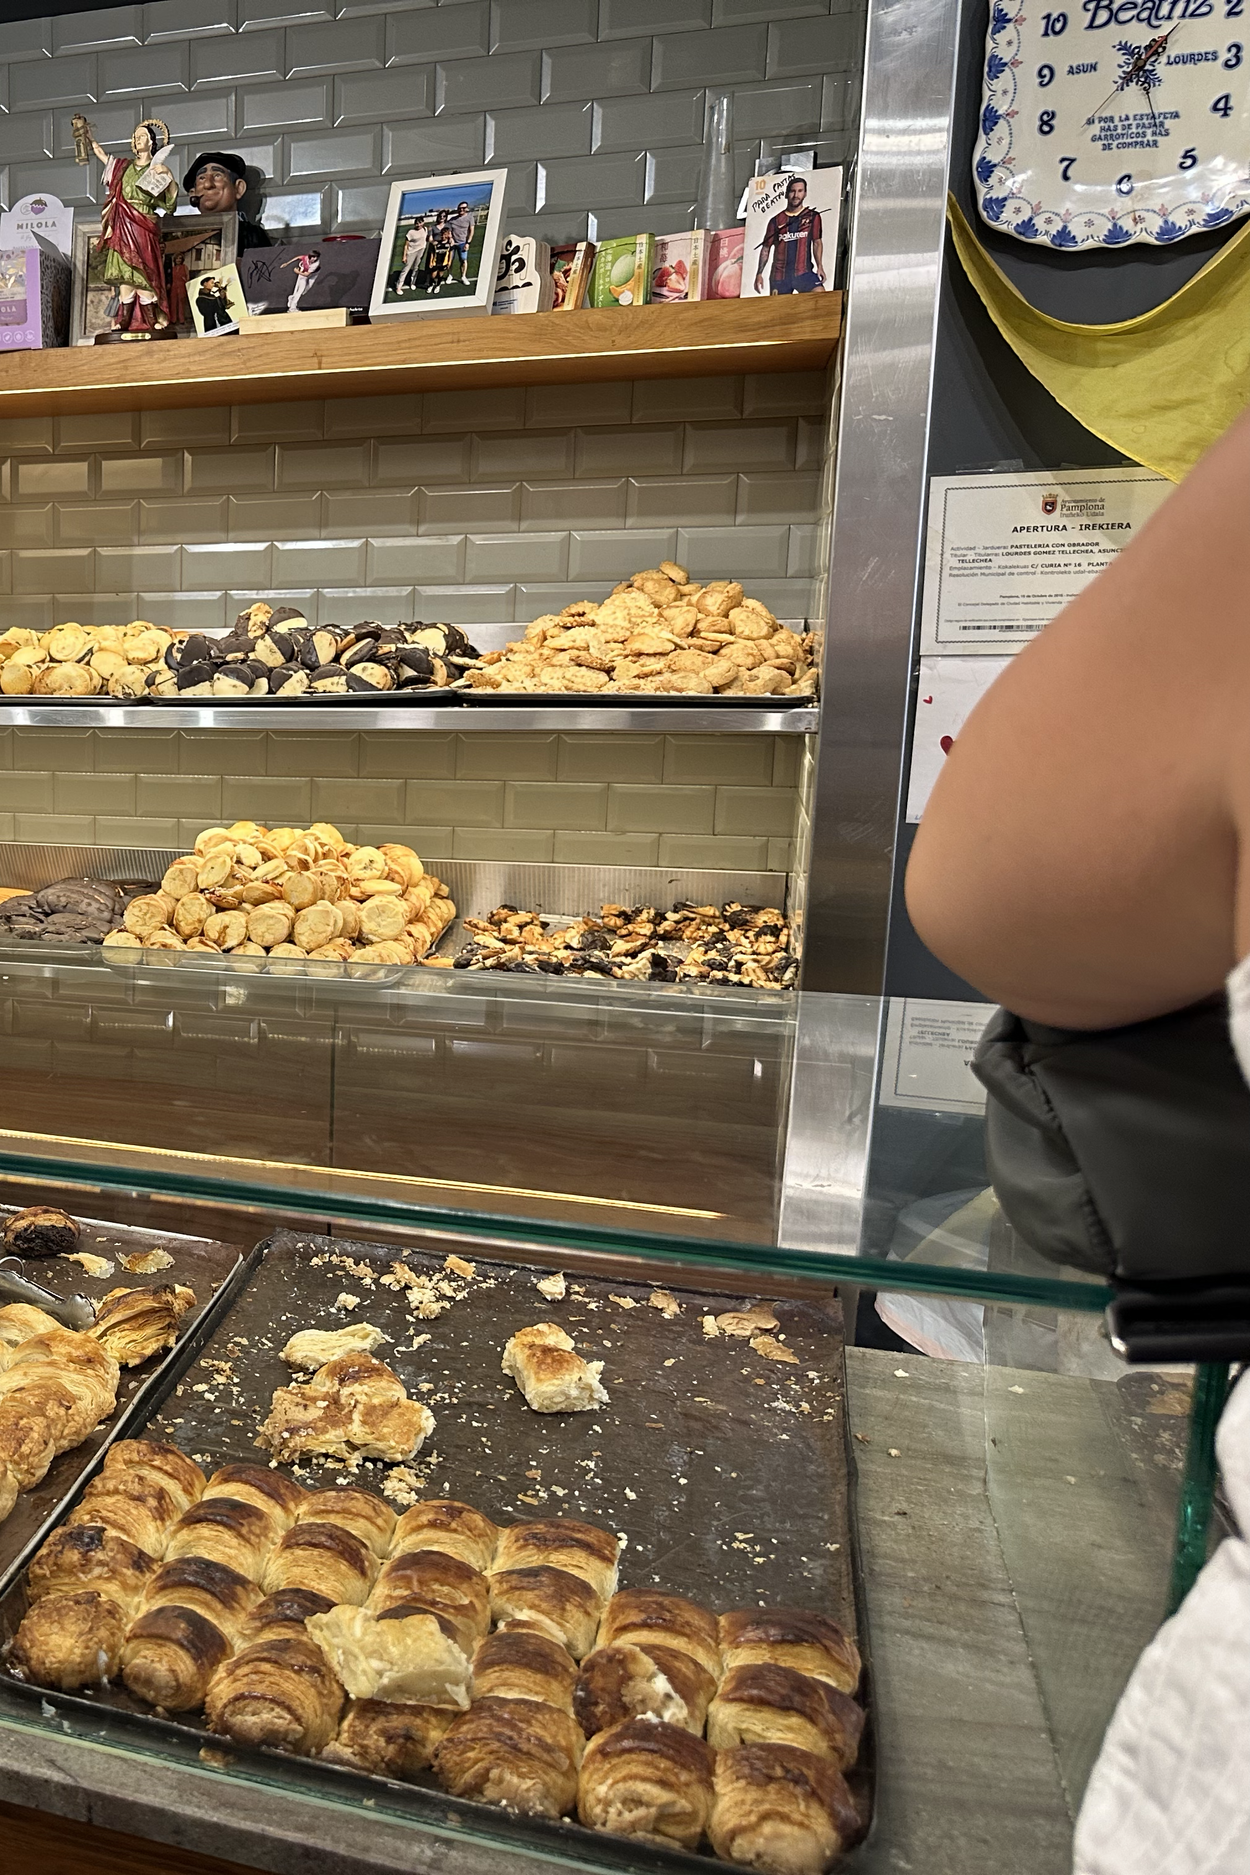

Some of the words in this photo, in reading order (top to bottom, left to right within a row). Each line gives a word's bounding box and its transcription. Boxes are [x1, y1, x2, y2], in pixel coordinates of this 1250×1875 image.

[1041, 11, 1069, 37] 10
[1165, 51, 1219, 66] LOURDES
[1222, 42, 1243, 70] 3
[1037, 63, 1055, 88] 9
[1067, 62, 1098, 76] ASUN
[1210, 93, 1234, 118] 4
[1037, 109, 1056, 136] 8
[1098, 116, 1114, 124] POR
[1133, 111, 1180, 122] ESTAFETA
[1100, 125, 1118, 133] HAS
[1136, 121, 1165, 130] PASAR
[1152, 129, 1170, 137] HAS
[1102, 143, 1113, 151] DE
[1116, 139, 1159, 149] COMPRAR
[1177, 147, 1198, 171] 5
[1058, 156, 1077, 182] 7
[1116, 173, 1134, 196] 6
[16, 221, 57, 230] MILOLA
[1060, 503, 1105, 513] Pamplona
[1012, 524, 1068, 533] APERTURA
[1079, 522, 1132, 531] IREKIERA
